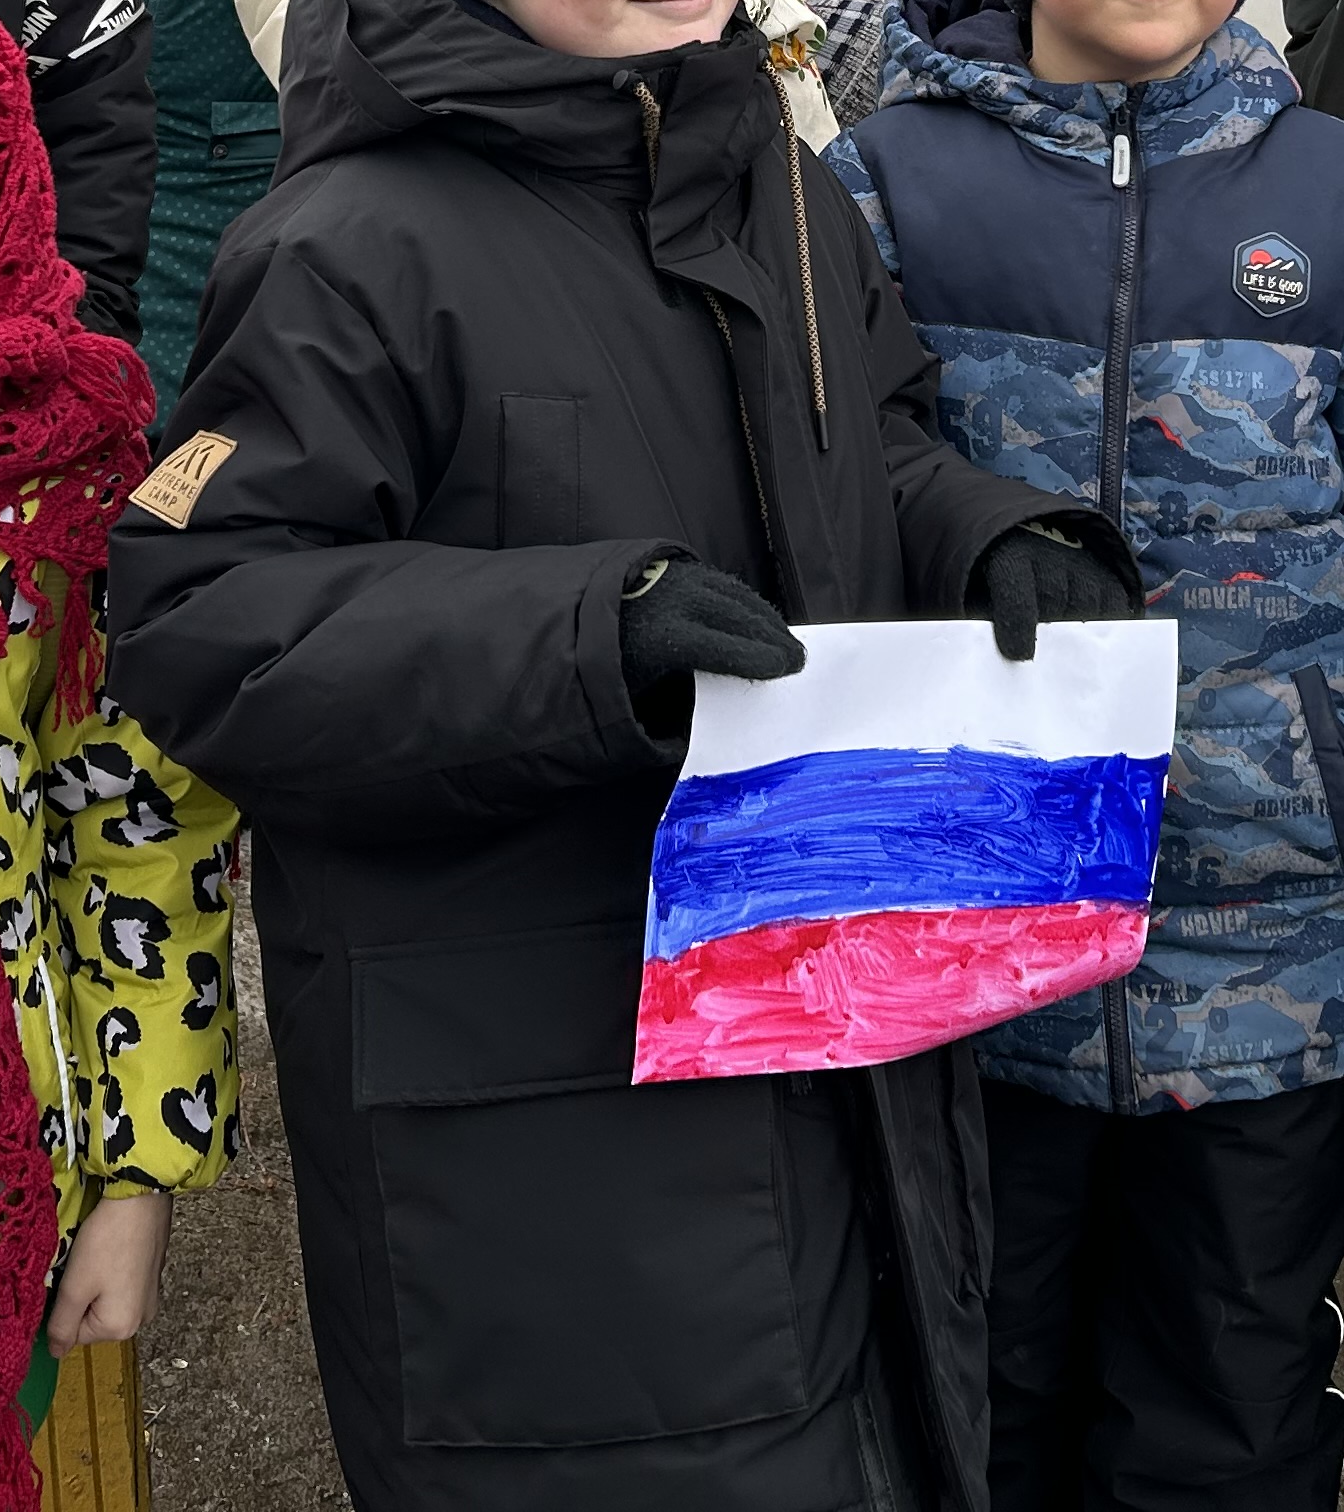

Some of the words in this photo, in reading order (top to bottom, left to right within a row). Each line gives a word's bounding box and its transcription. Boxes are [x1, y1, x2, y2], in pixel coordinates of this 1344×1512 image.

[1243, 272, 1265, 287] LIFE
[1279, 279, 1304, 295] GOOD
[152, 469, 197, 500] EXTREME
[147, 485, 178, 508] CAMP
